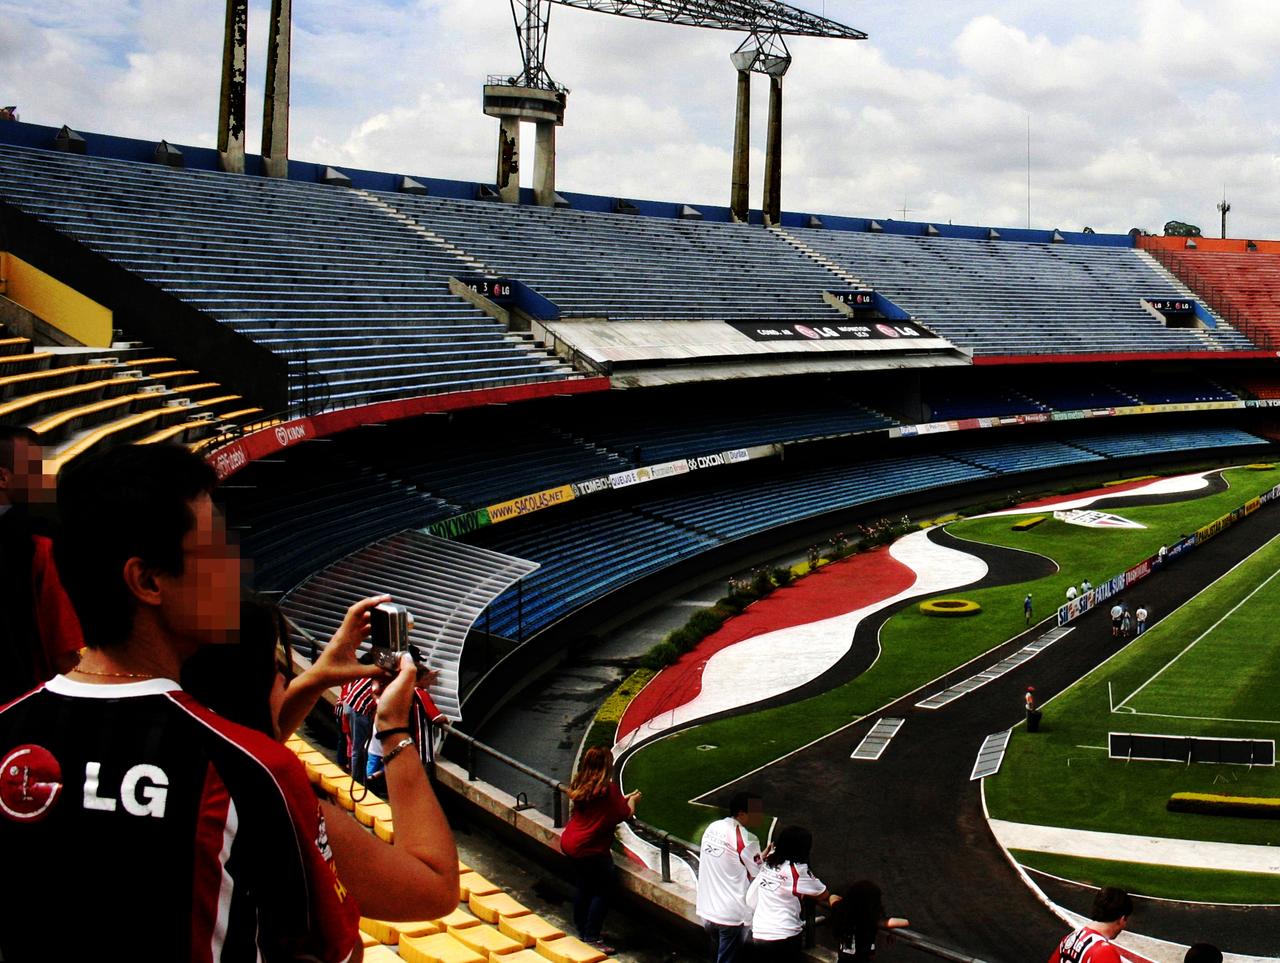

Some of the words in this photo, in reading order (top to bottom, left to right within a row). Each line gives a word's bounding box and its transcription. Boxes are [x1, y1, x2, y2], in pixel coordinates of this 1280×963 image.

[813, 327, 840, 337] LG
[896, 327, 920, 337] LG
[697, 452, 725, 468] OXON
[1095, 581, 1112, 604] FATAL
[1112, 573, 1125, 594] SURF
[83, 761, 169, 818] LG
